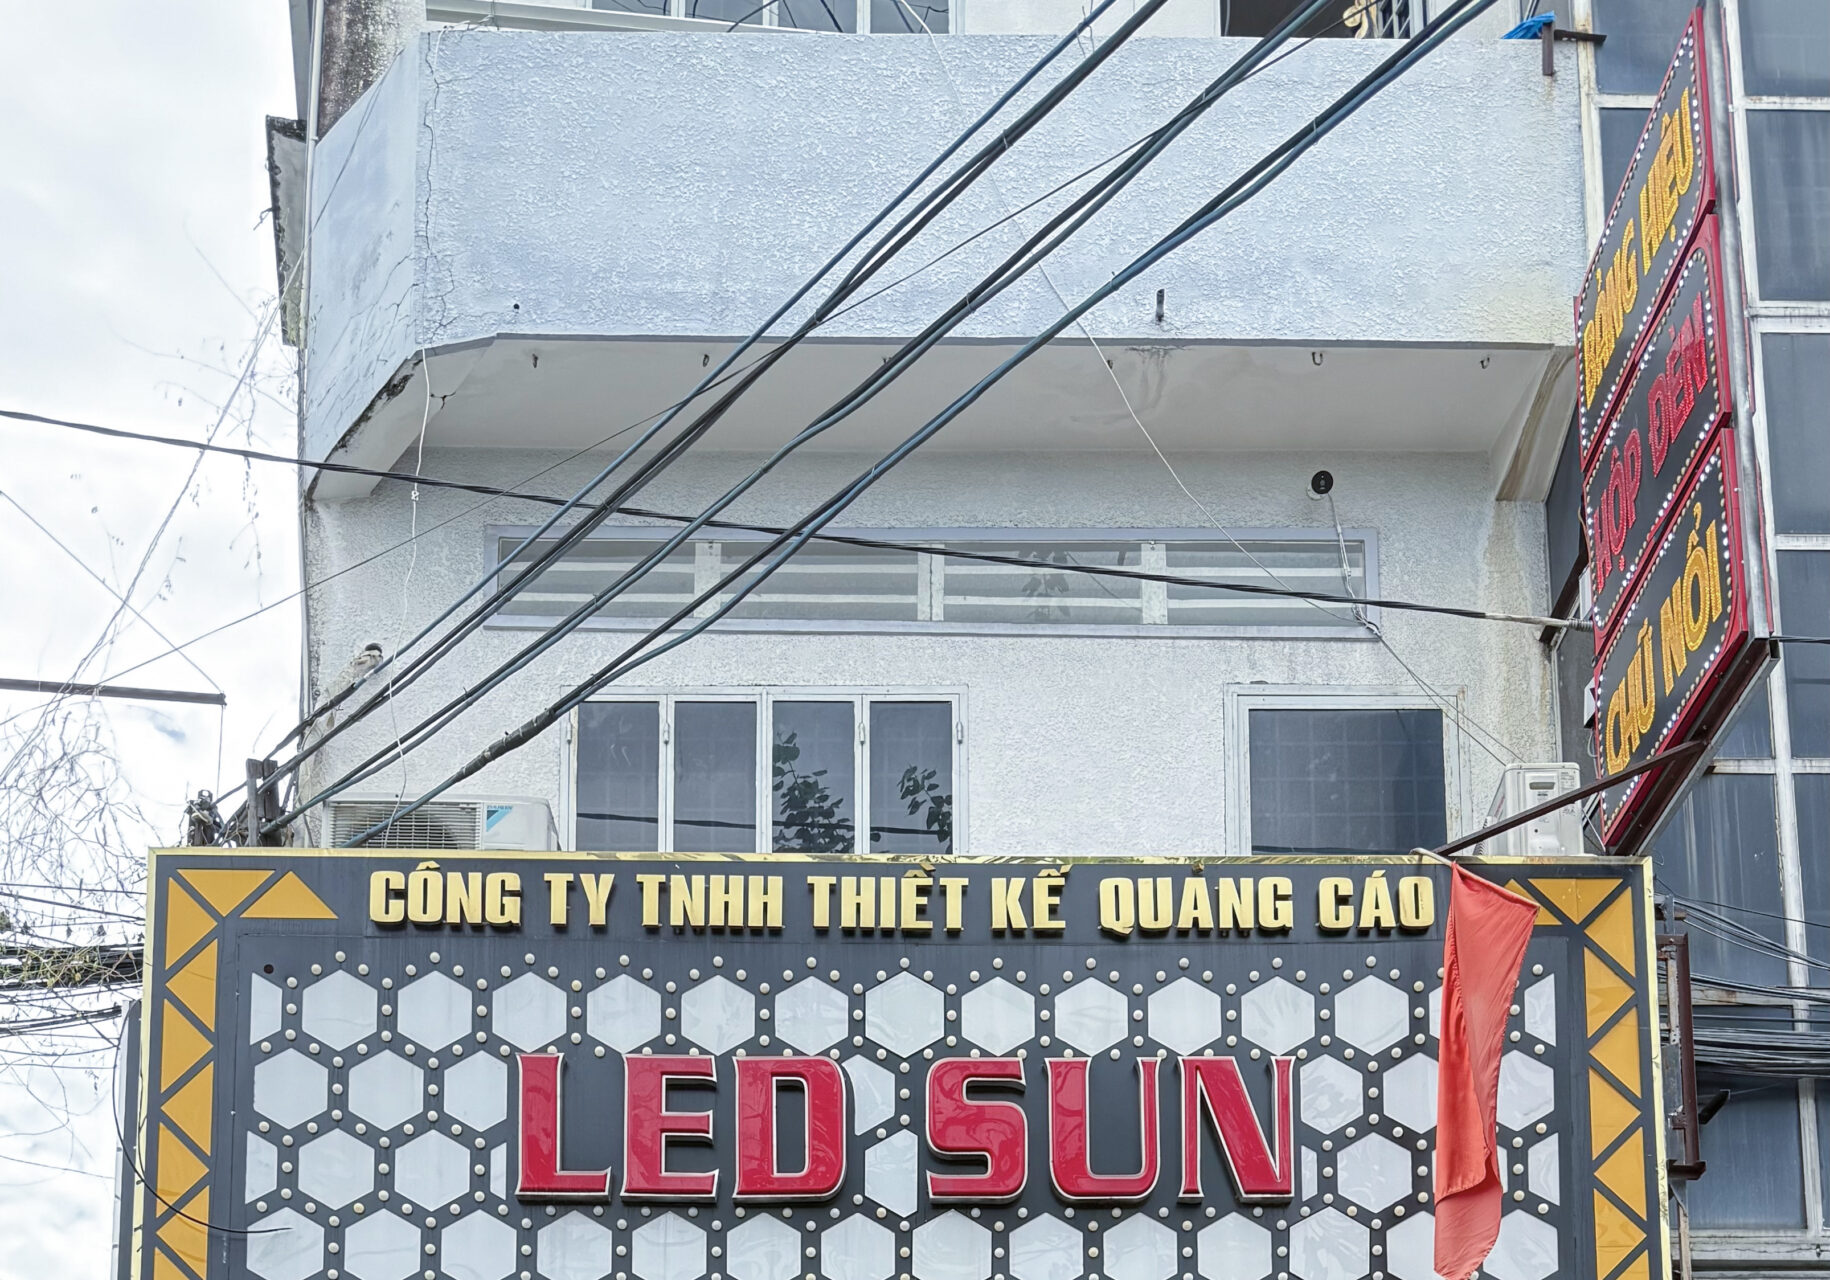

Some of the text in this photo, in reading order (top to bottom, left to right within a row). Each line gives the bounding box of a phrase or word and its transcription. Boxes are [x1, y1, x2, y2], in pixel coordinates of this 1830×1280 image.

[1584, 86, 1695, 409] BẢNG HIỆU
[1594, 291, 1709, 594] HỘP ĐÈN
[1606, 502, 1722, 776] CHỮ NỔI
[369, 860, 521, 926] CÔNG
[544, 872, 616, 928] TY
[636, 874, 784, 930] TNHH
[991, 863, 1073, 932] KẾ
[1318, 869, 1436, 931] CÁO
[516, 1052, 1296, 1203] LED SUN
